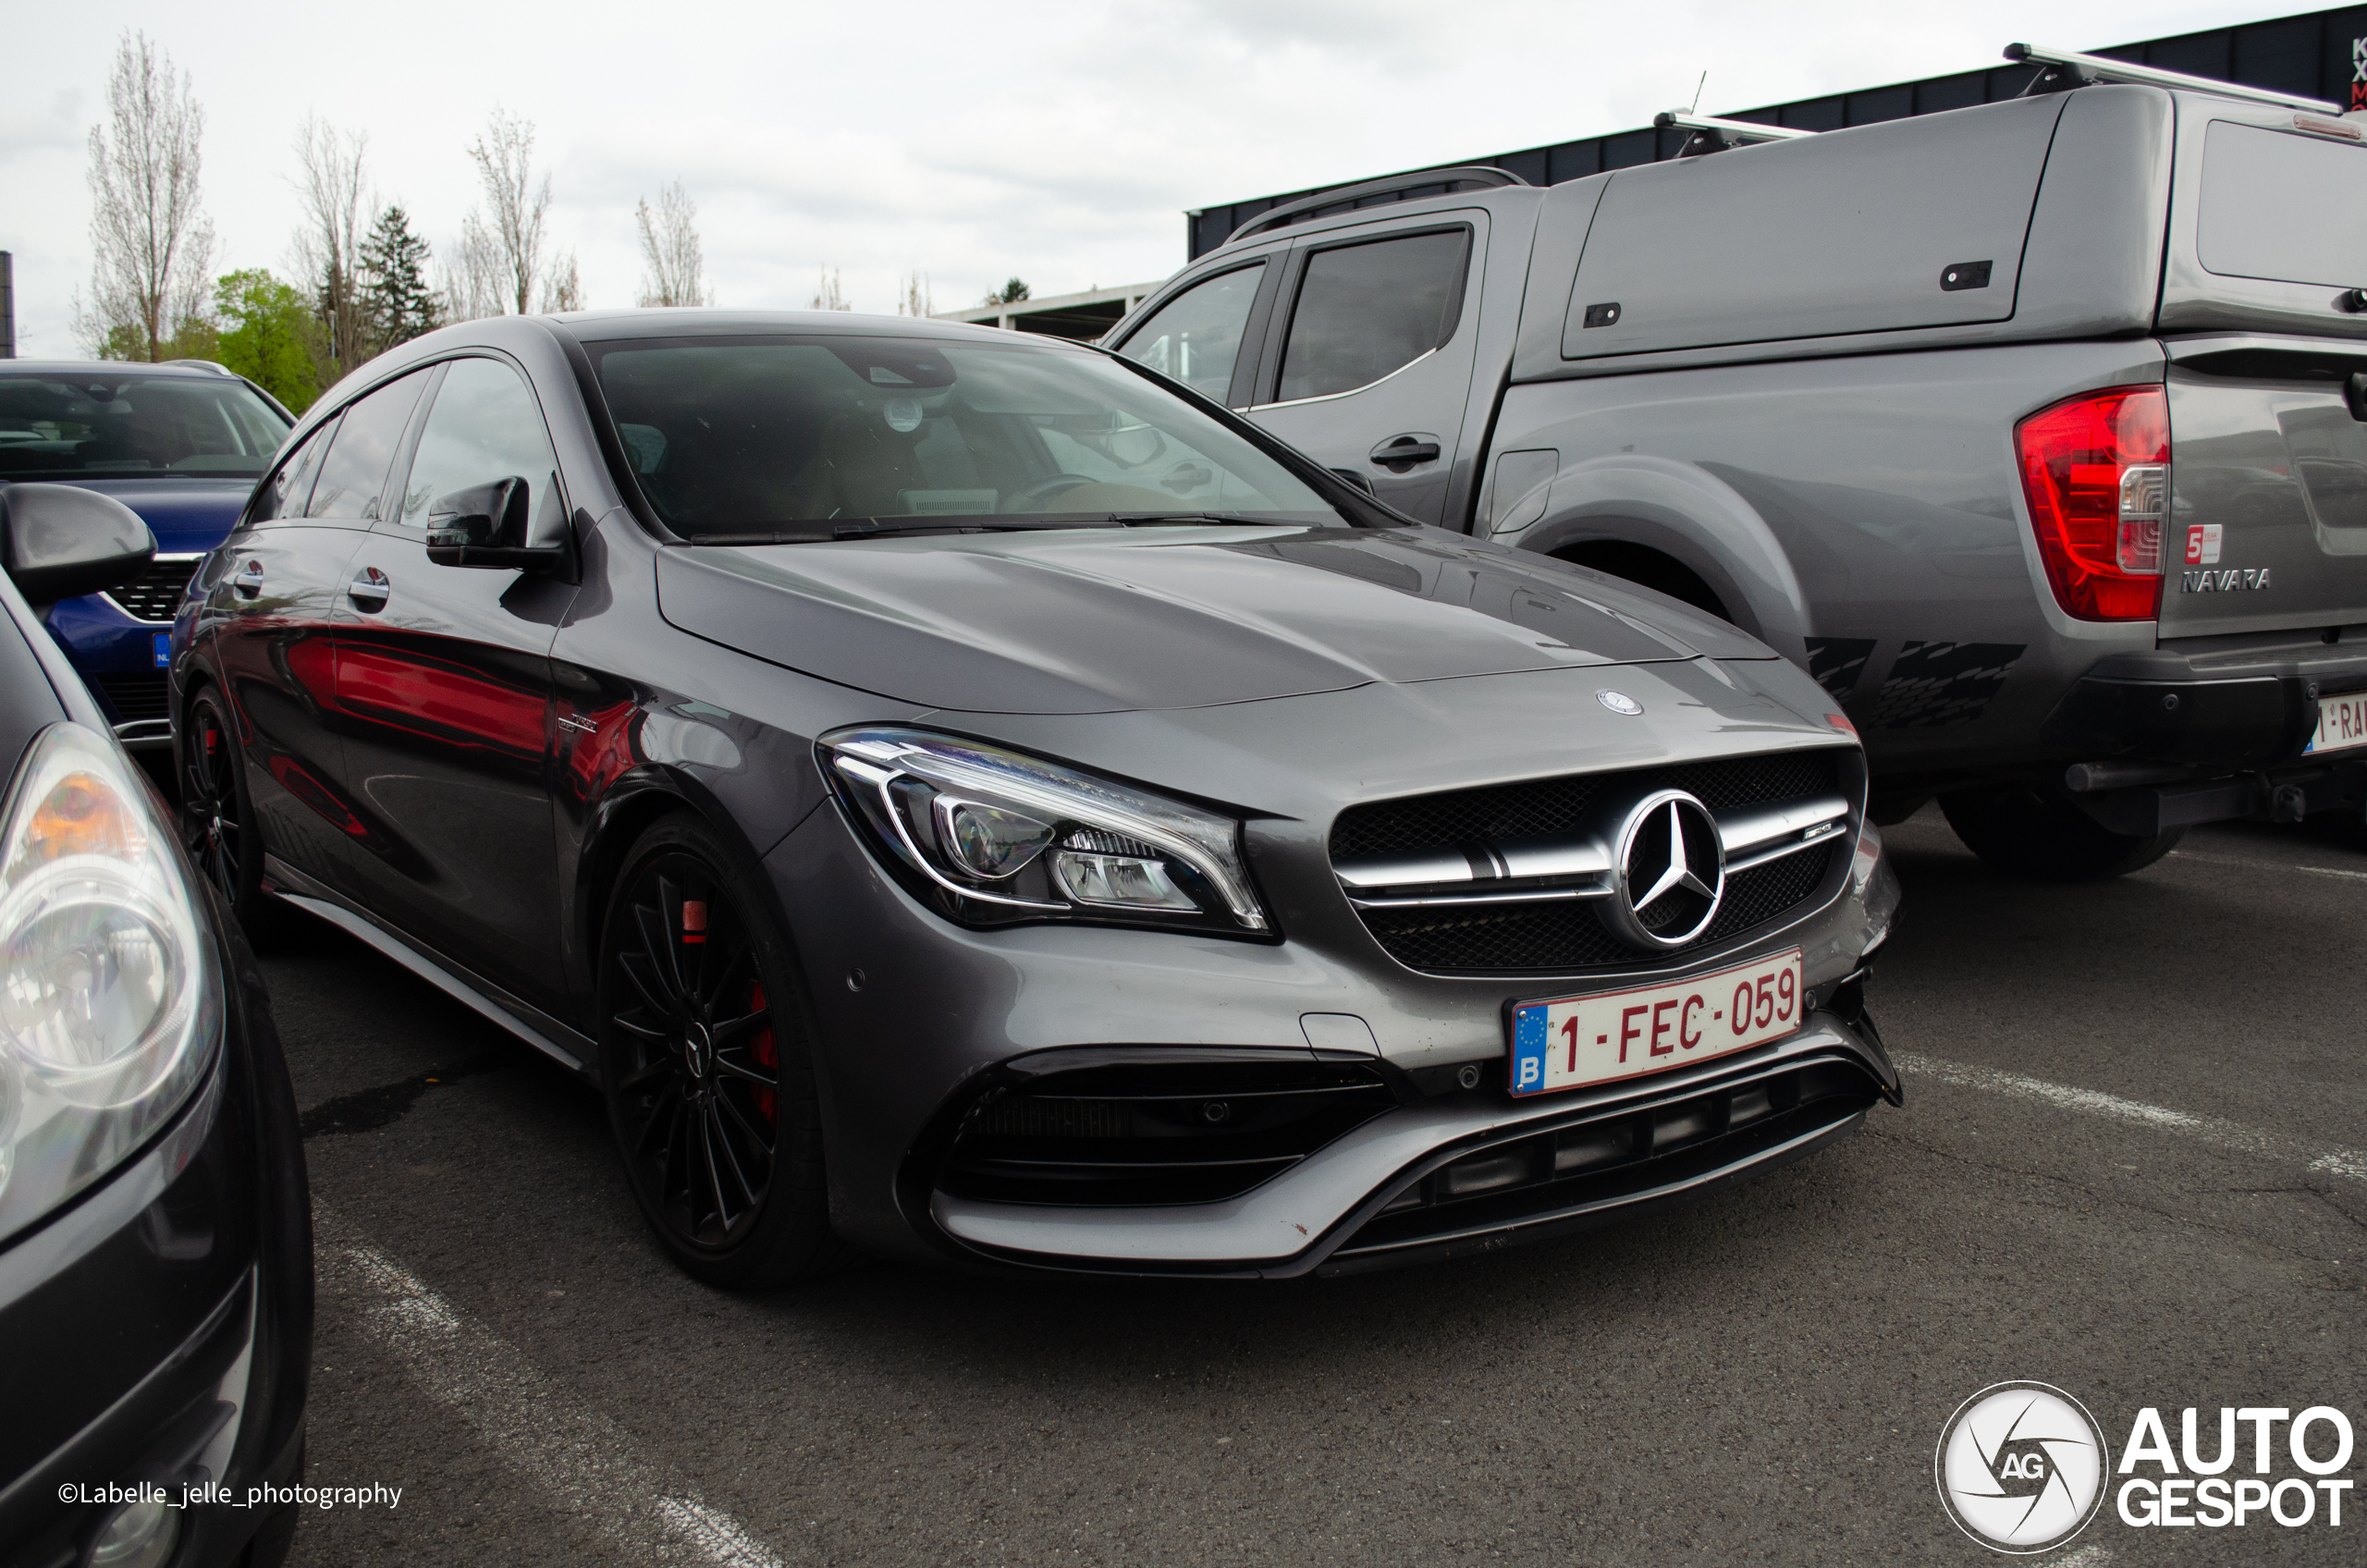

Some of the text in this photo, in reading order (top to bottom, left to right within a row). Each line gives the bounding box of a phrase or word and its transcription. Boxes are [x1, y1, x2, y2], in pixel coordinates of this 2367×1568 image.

[2188, 533, 2201, 558] 5
[2180, 568, 2271, 594] NAVARA
[156, 654, 170, 662] NL
[571, 713, 598, 731] TURBO
[686, 830, 731, 875] BRIDGESTONE
[1561, 967, 1796, 1072] 1-FEC-059
[1520, 1056, 1539, 1084] B
